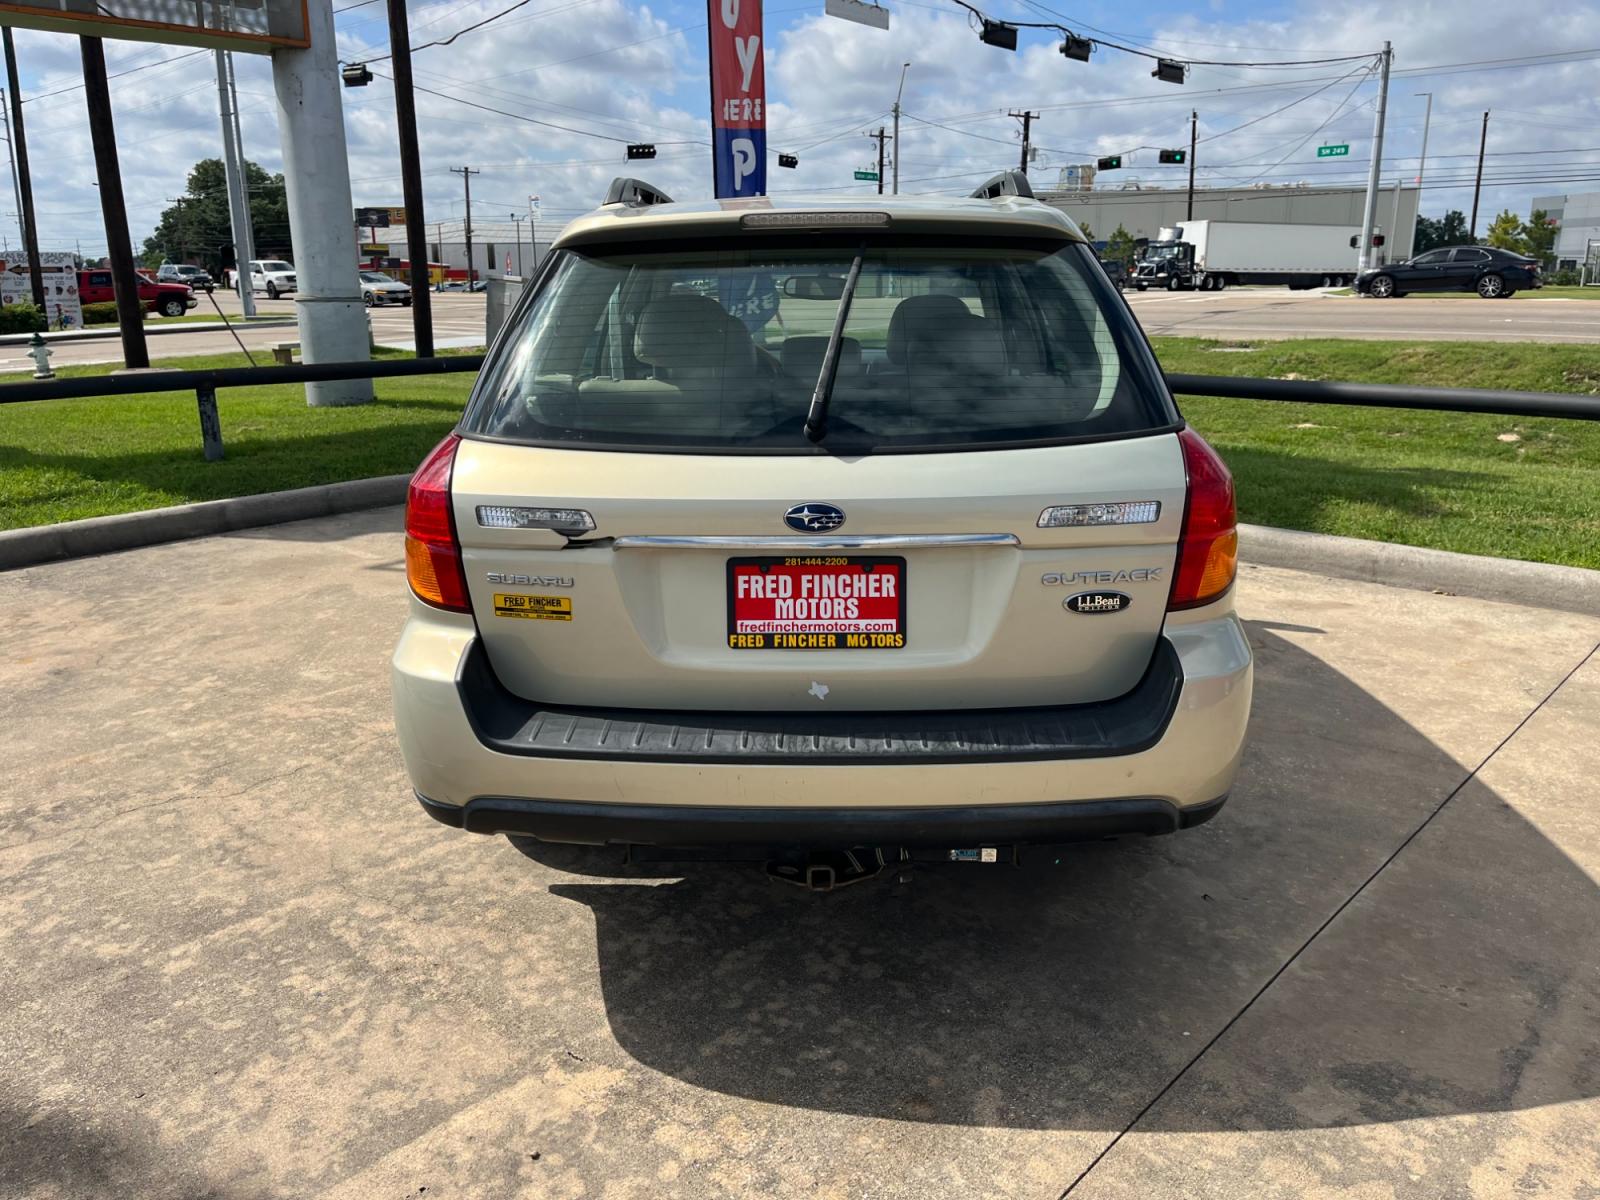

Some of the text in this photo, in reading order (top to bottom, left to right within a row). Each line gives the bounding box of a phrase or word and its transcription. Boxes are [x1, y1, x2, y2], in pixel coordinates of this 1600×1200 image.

[785, 557, 848, 566] 281-444-2200
[487, 572, 575, 588] SUBARU
[1041, 567, 1163, 586] OUTBACK
[737, 574, 896, 599] FRED FINCHER
[503, 596, 562, 608] FRED FINCHER
[775, 598, 859, 619] MOTORS
[739, 621, 894, 633] fredfinchermotors.com
[729, 634, 904, 648] FRED FINCHER MOTORS
